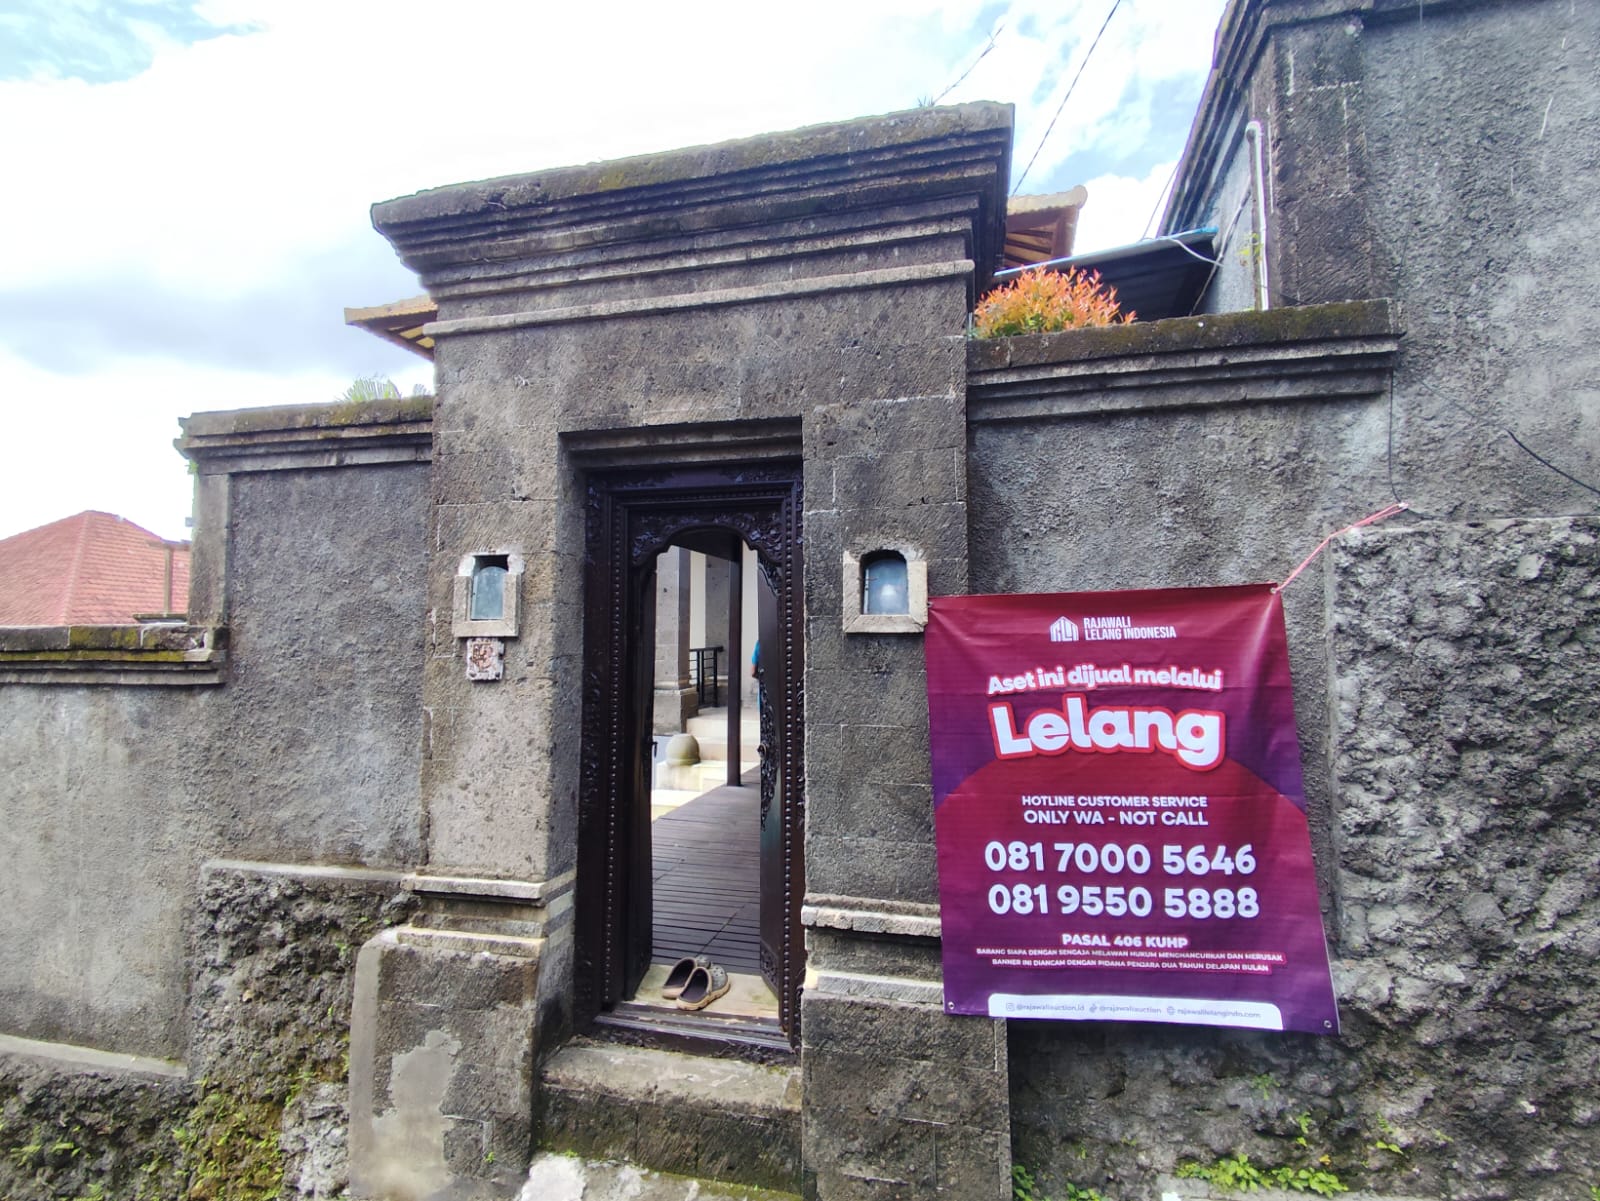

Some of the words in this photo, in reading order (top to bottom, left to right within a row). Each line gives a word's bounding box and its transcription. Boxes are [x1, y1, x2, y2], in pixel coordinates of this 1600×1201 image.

[1083, 616, 1131, 629] RAJAWALI
[1084, 628, 1122, 641] LELANG
[1124, 626, 1177, 640] INDONESIA
[987, 672, 1036, 695] Aset
[1036, 667, 1065, 687] ini
[1067, 664, 1132, 689] dijual
[1134, 665, 1222, 690] melalui
[991, 696, 1221, 766] Lelang
[1021, 795, 1075, 807] HOTLINE
[1077, 796, 1150, 808] CUSTOMER
[1152, 796, 1208, 808] SERVICE
[1023, 809, 1069, 824] ONLY
[1073, 811, 1104, 825] WA
[1119, 811, 1157, 826] NOT
[1161, 811, 1208, 826] CALL
[984, 841, 1045, 872] 081
[1053, 842, 1151, 874] 7000
[1162, 844, 1257, 876] 5646
[988, 883, 1049, 915] 081
[1057, 885, 1152, 917] 9550
[1164, 887, 1259, 919] 5888
[1062, 933, 1110, 946] PASAL
[1114, 935, 1142, 947] 406
[1145, 936, 1188, 949] KUHP
[1007, 948, 1027, 956] SIAPA
[1245, 954, 1283, 962] MERUSAK
[1033, 959, 1065, 967] DIANCAM
[1067, 959, 1096, 967] DENGAN
[1179, 962, 1205, 970] TAHUN
[1206, 963, 1241, 971] DELAPAN
[1242, 964, 1269, 972] BULAN
